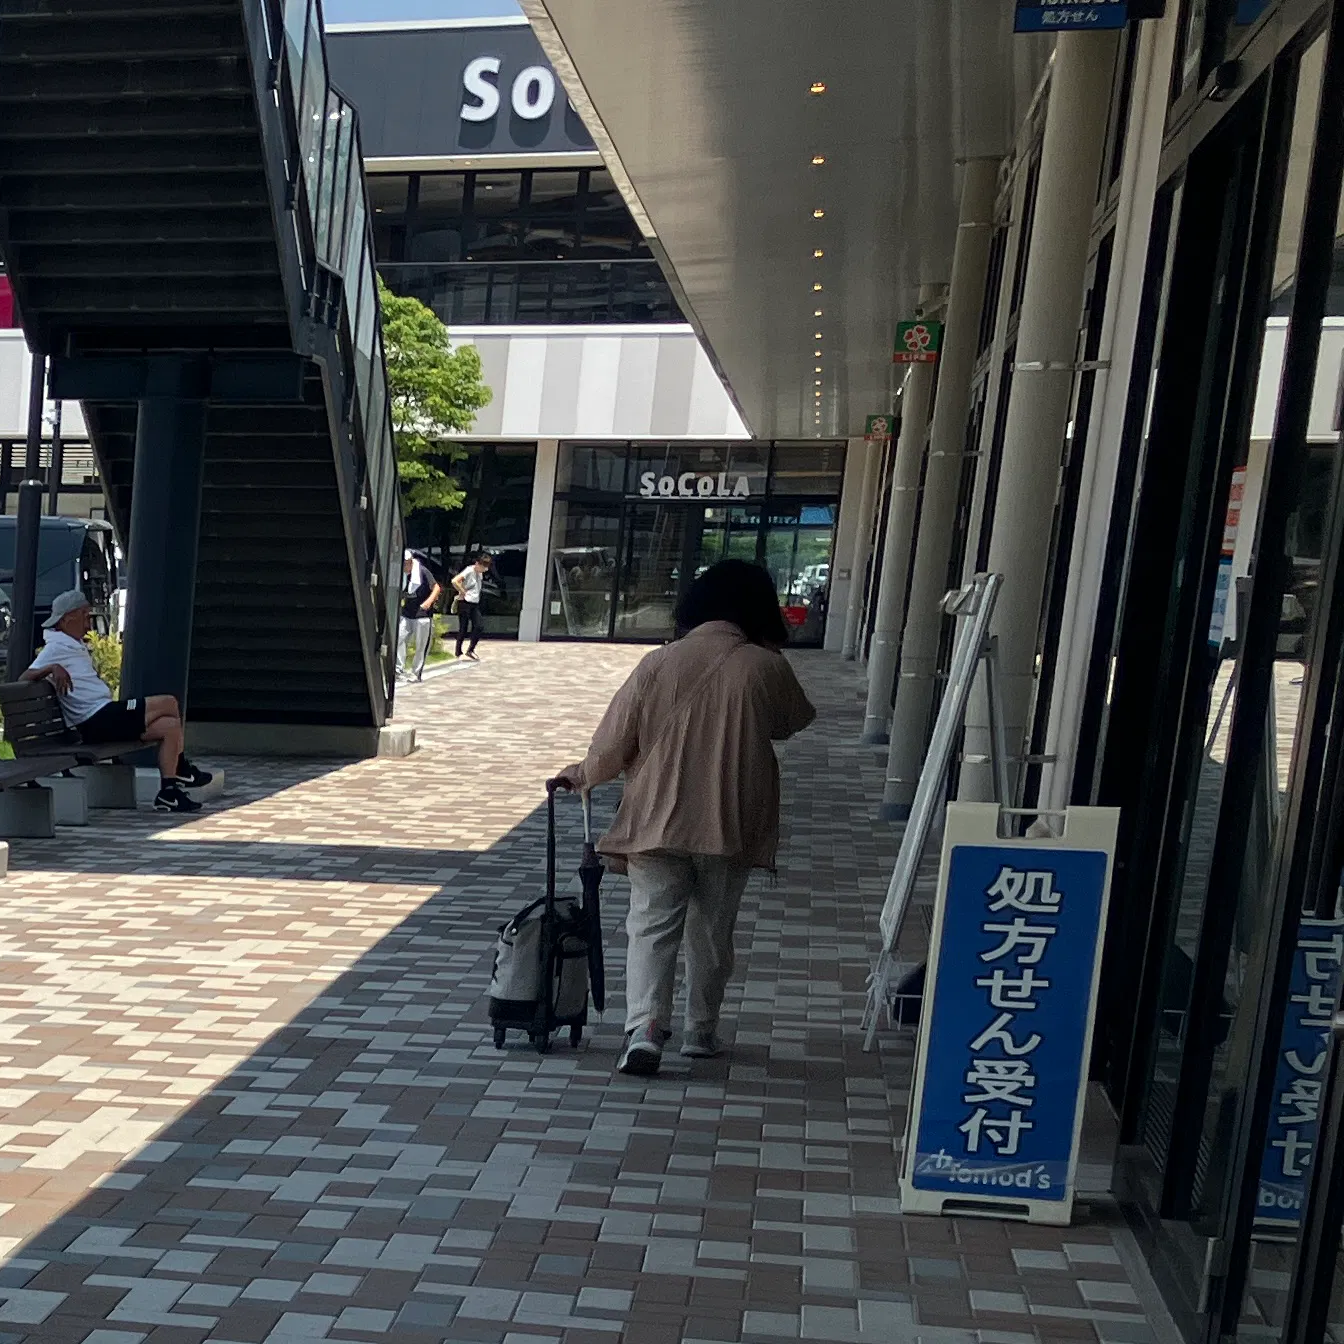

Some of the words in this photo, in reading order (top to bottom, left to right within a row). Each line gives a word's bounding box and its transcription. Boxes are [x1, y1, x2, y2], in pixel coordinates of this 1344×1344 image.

[460, 56, 577, 121] So
[959, 867, 1062, 1155] 処方せん受付
